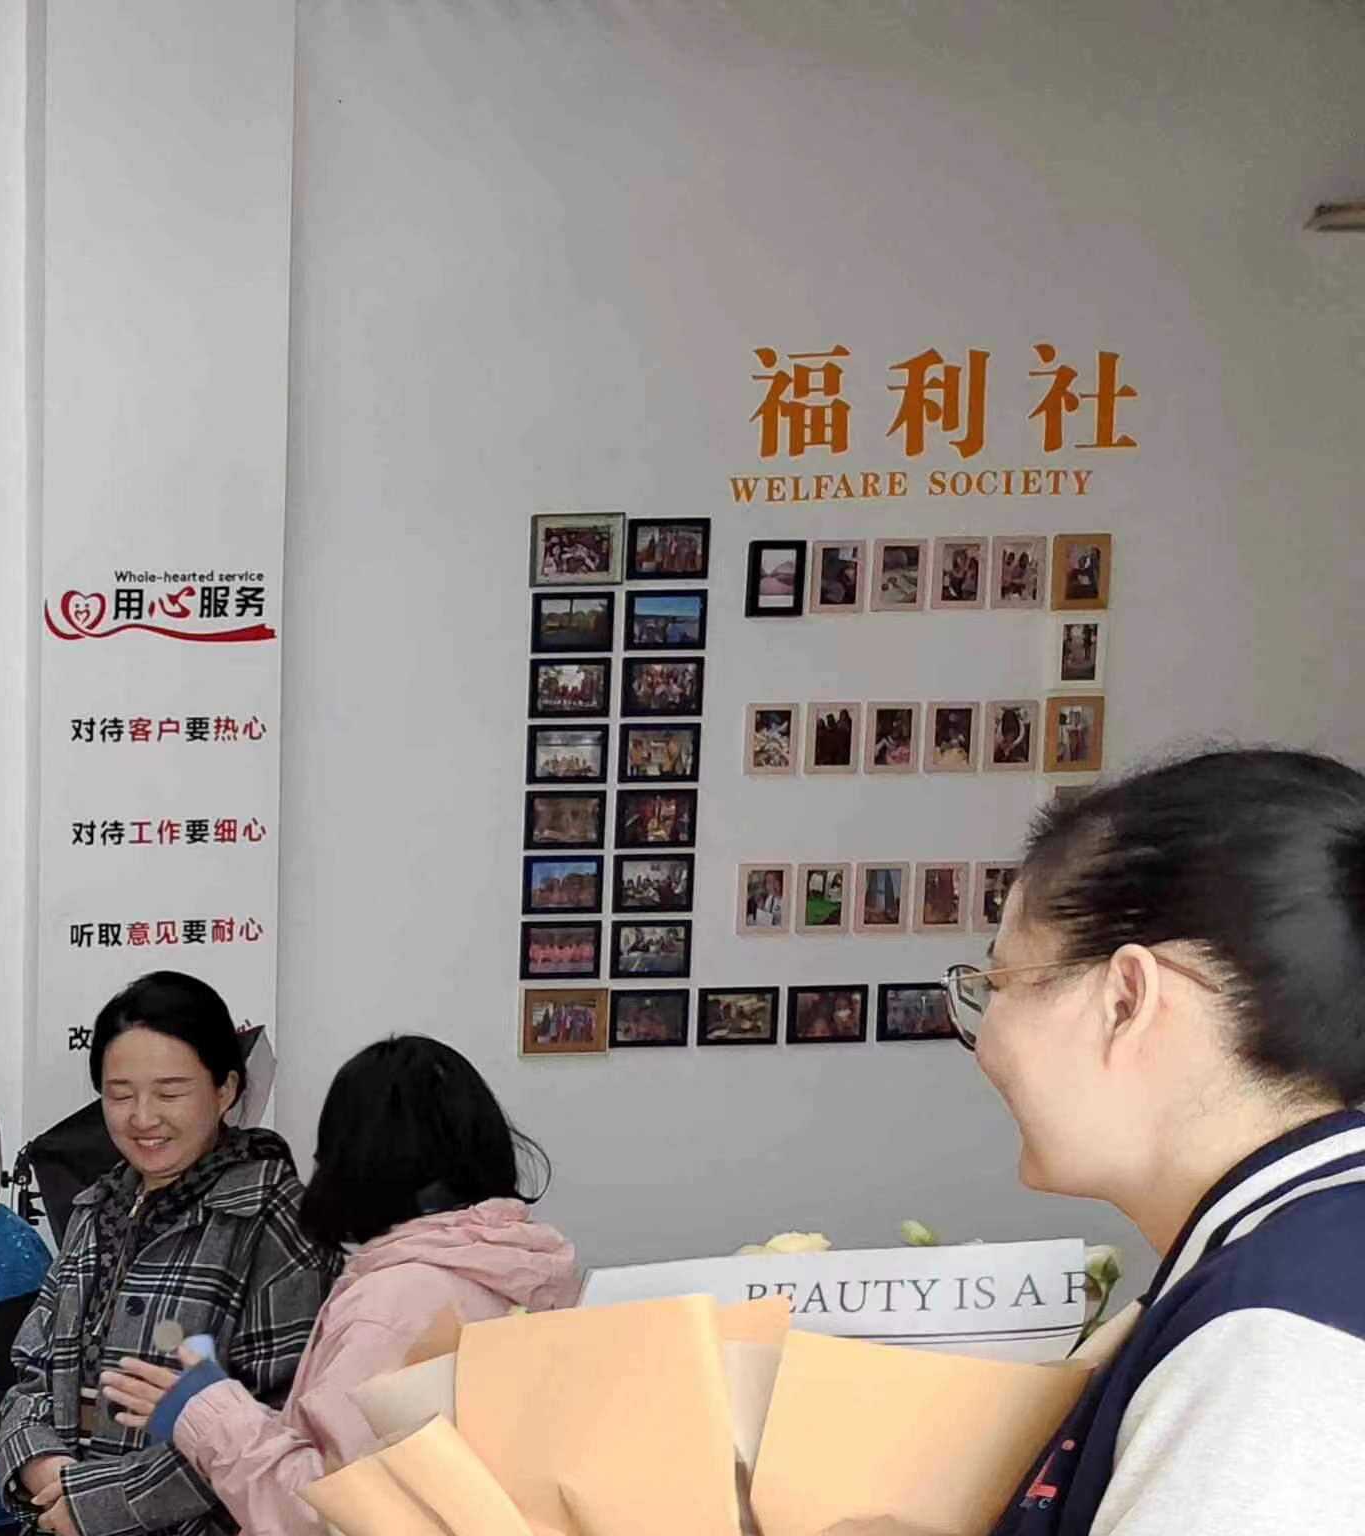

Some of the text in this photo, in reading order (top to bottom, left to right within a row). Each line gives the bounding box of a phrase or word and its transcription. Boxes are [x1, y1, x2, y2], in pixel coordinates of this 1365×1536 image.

[749, 342, 1138, 458] 福利社
[729, 469, 1094, 503] WELFARE SOCIETY
[113, 570, 264, 584] Whole-hearted service
[112, 584, 266, 621] 用心服务
[70, 716, 267, 744] 对待客户要热心
[71, 818, 267, 847] 对待工作要细心
[69, 917, 263, 948] 听取意见要耐心
[957, 1276, 996, 1310] IS
[1010, 1273, 1047, 1307] A
